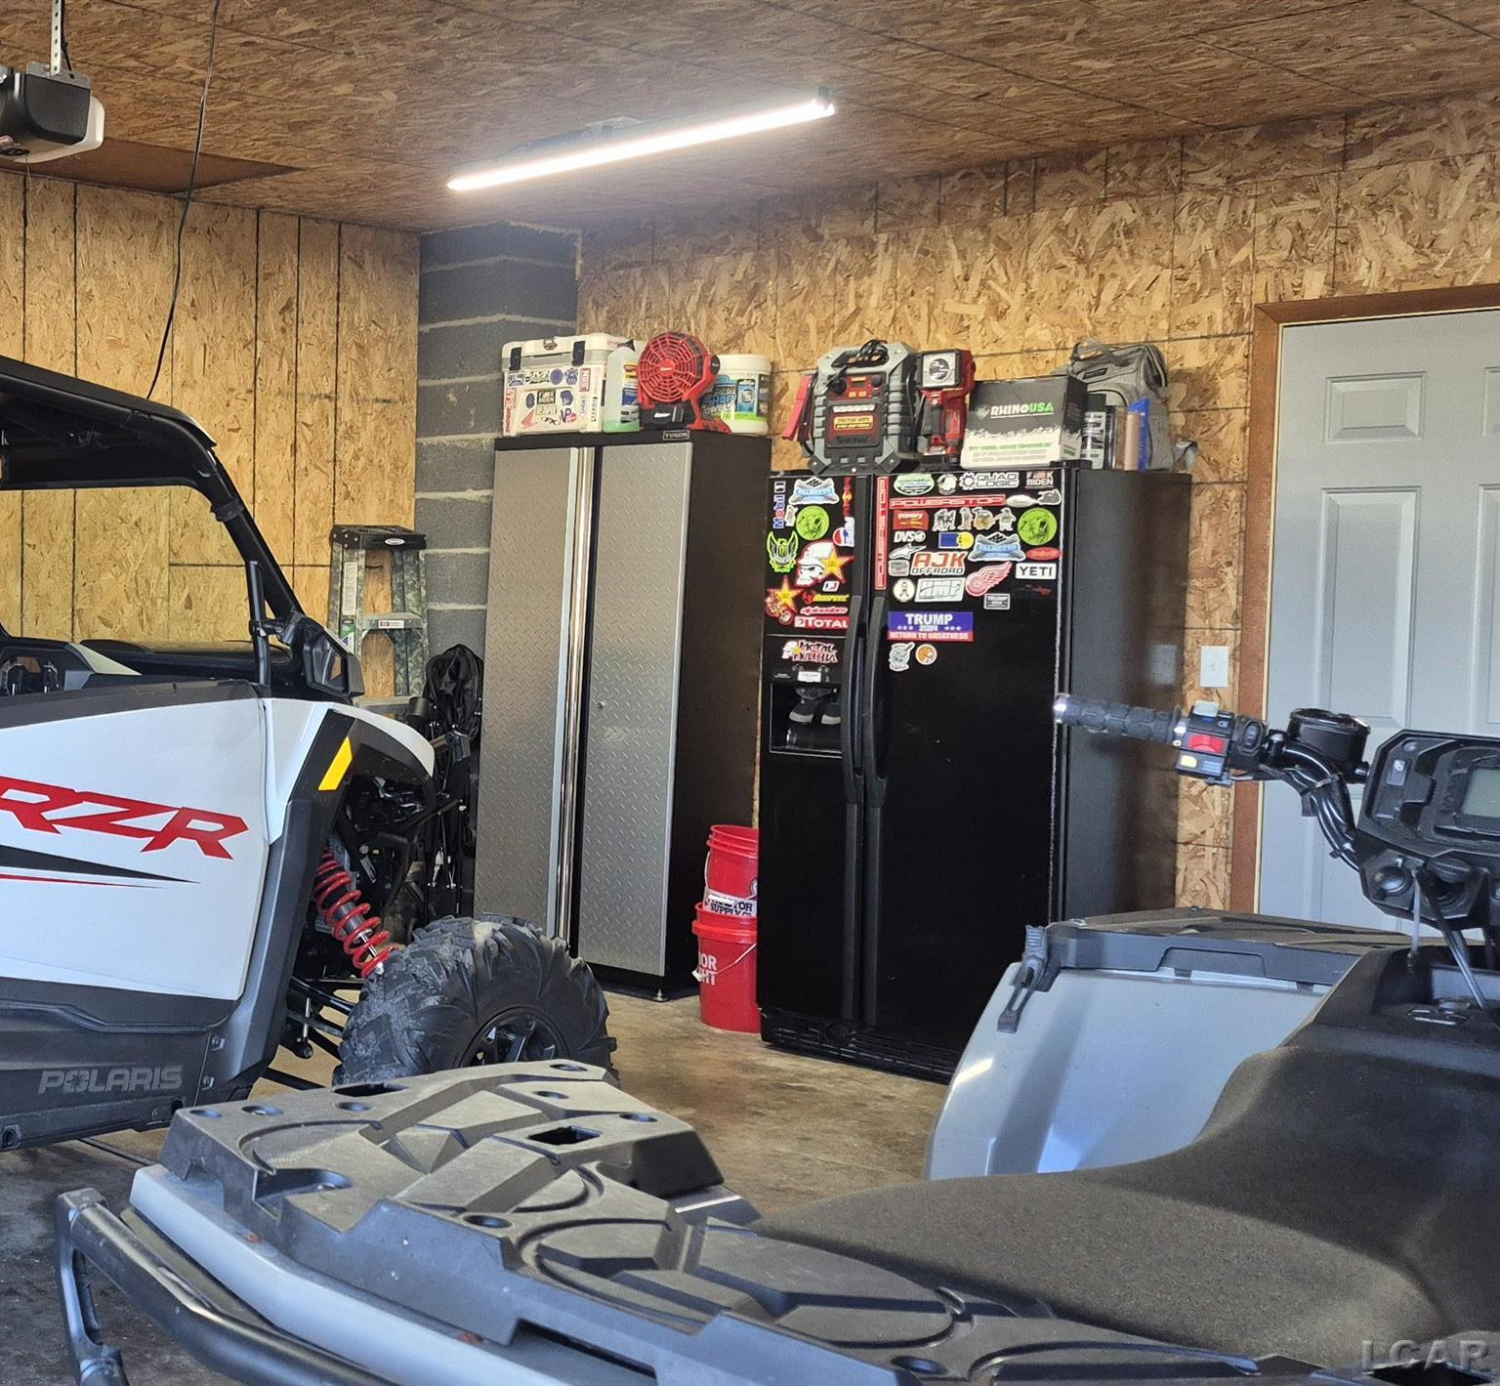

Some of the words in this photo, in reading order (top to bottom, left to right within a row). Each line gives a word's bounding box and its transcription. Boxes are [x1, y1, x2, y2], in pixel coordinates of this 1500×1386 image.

[891, 496, 1005, 510] POWERSTOP
[893, 531, 915, 542] DVS
[913, 552, 967, 568] AJK
[1019, 566, 1053, 576] YETI
[805, 616, 848, 628] TOTAL
[904, 613, 953, 625] TRUMP
[38, 1065, 182, 1094] POLARIS
